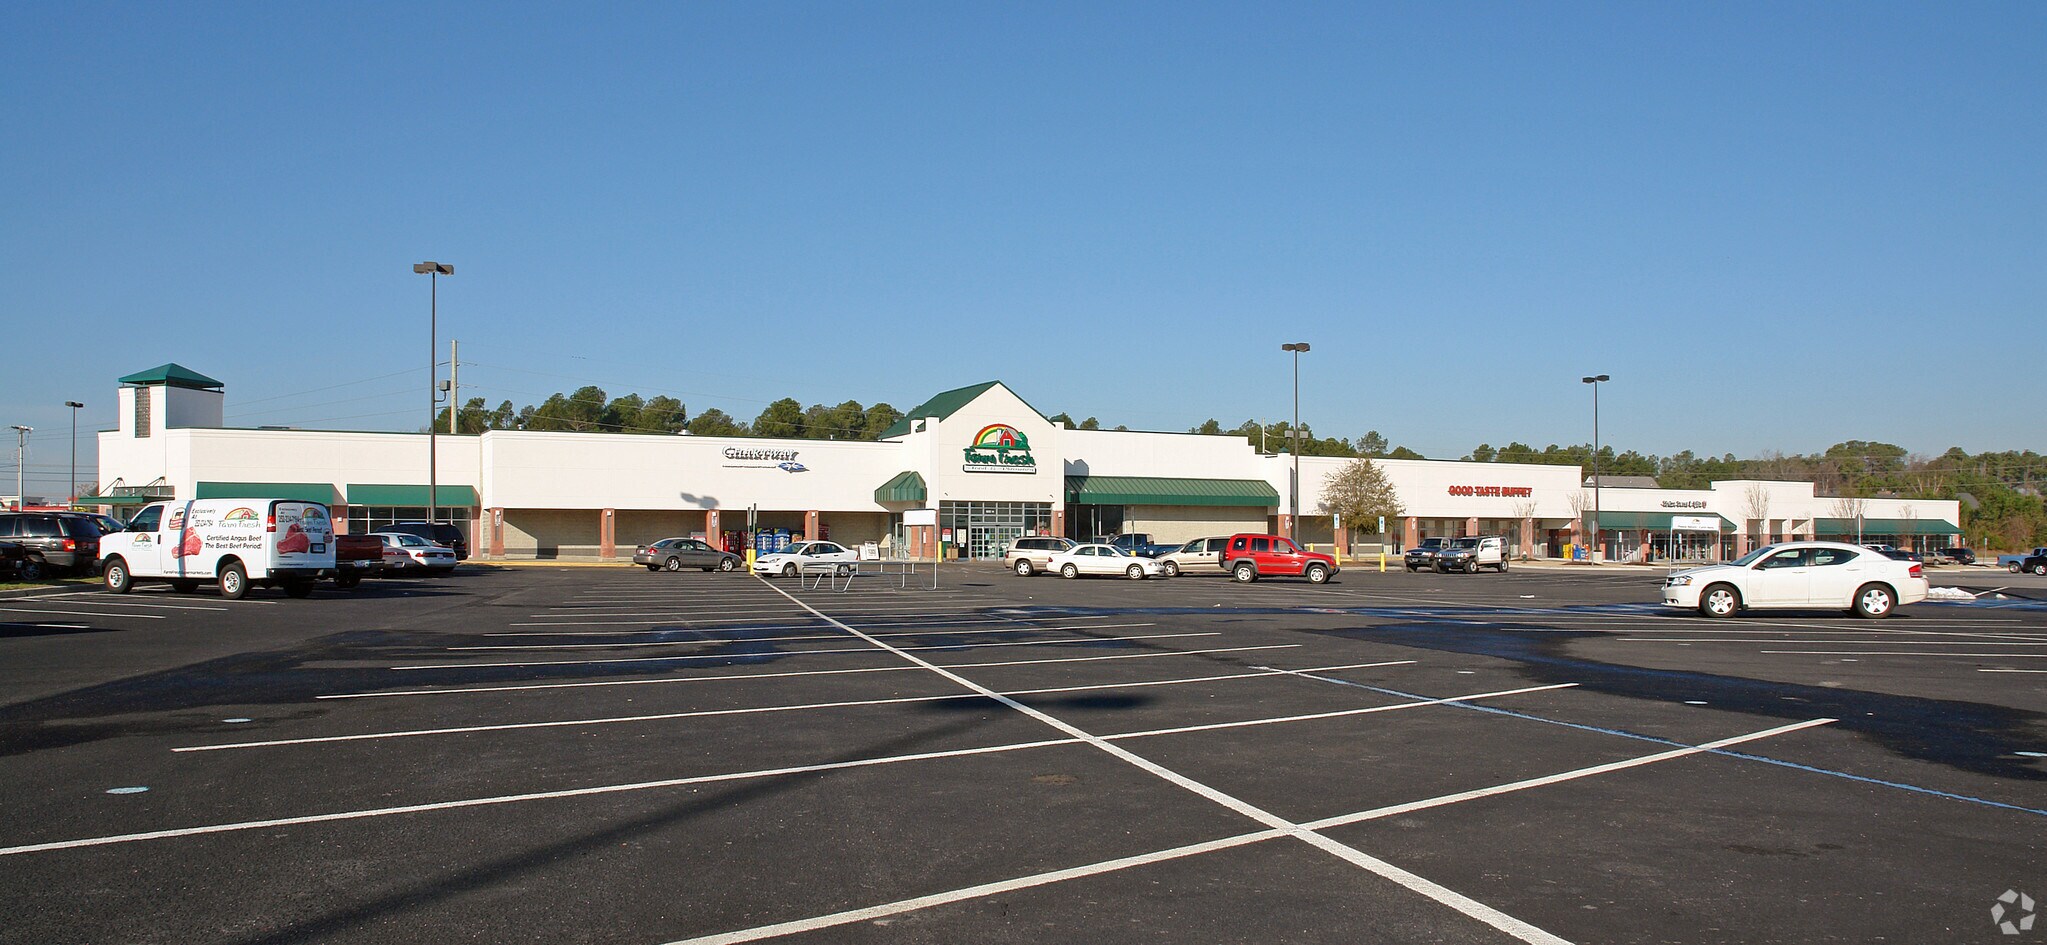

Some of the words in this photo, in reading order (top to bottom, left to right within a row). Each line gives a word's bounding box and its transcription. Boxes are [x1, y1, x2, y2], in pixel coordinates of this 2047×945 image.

[1448, 485, 1473, 497] GOOD
[1474, 486, 1501, 497] TASTE
[1501, 487, 1532, 498] BUFFET
[218, 520, 237, 528] Farm
[238, 519, 261, 528] Fresh
[230, 535, 247, 543] Angus
